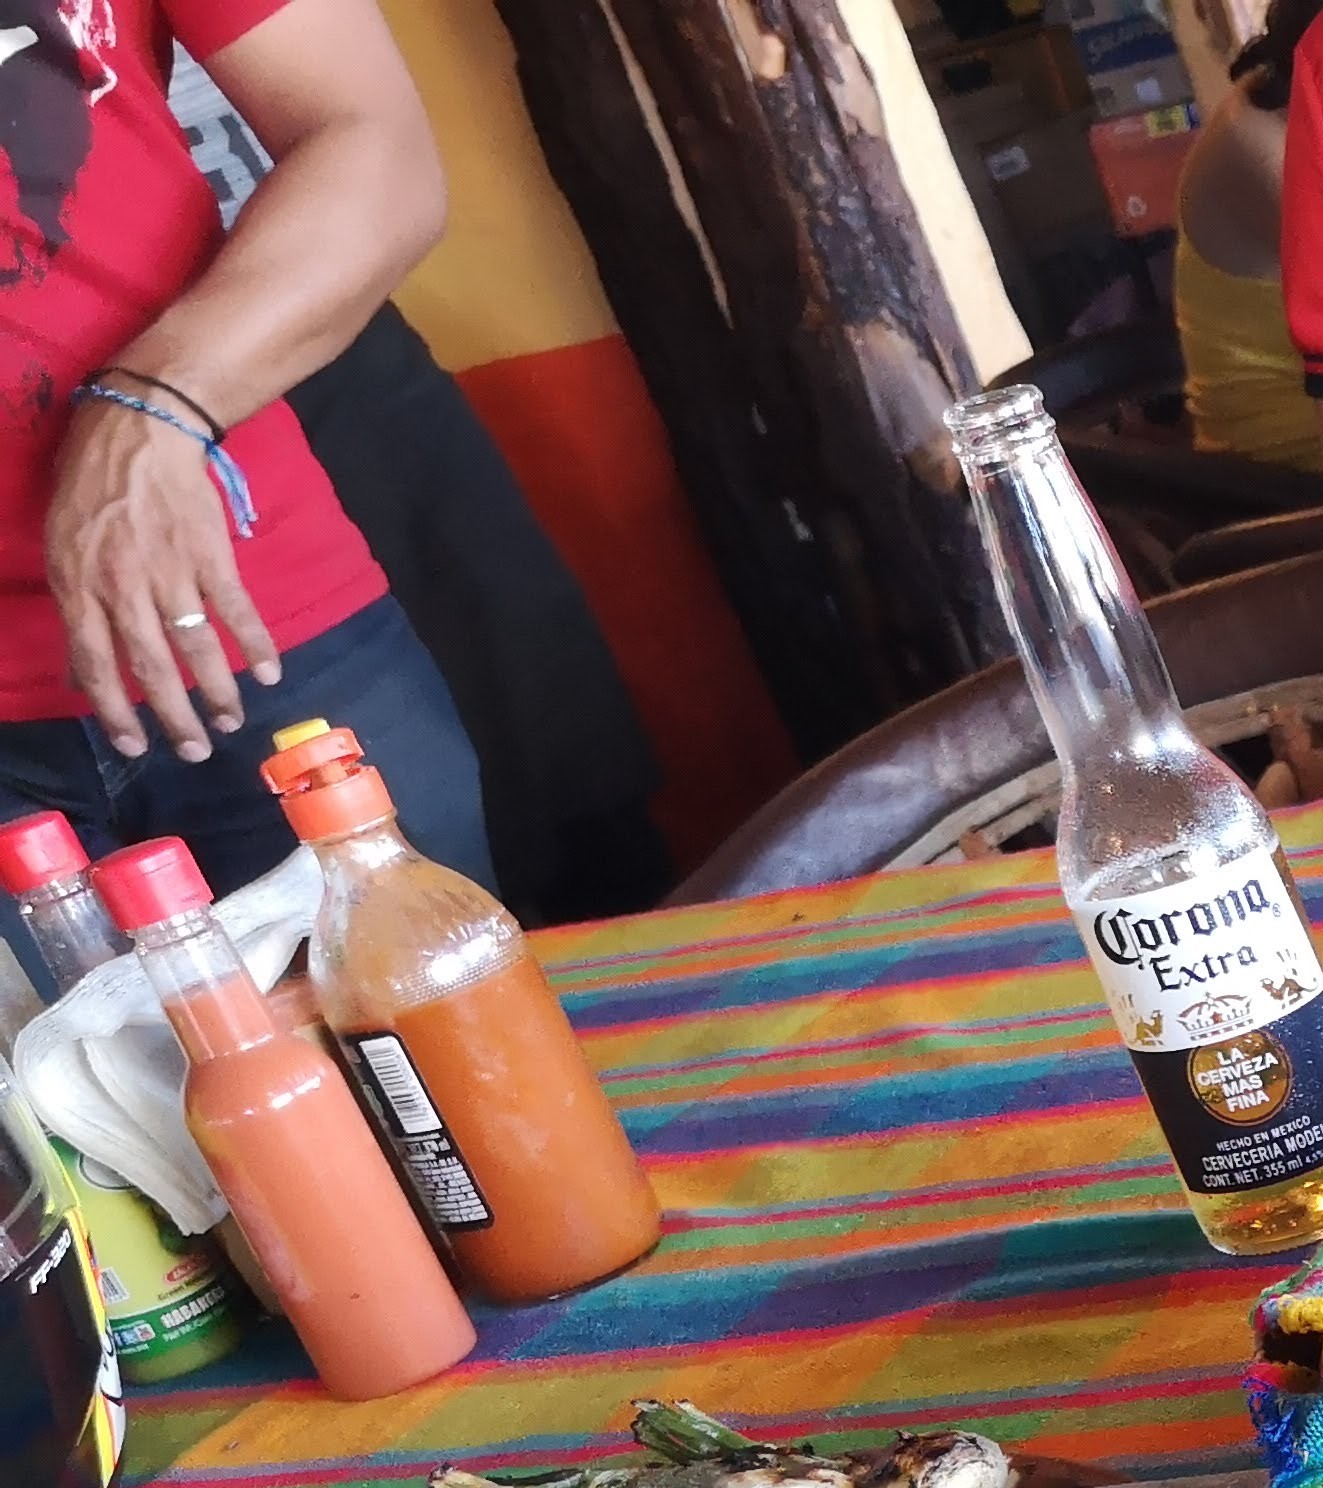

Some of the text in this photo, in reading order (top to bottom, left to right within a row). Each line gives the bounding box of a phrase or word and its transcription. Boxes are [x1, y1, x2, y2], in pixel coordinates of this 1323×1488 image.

[1093, 879, 1271, 971] Corona
[1149, 945, 1259, 992] Extra
[1195, 1051, 1279, 1087] CERVEZA
[1216, 1047, 1245, 1066] LA
[1221, 1074, 1263, 1098] MAS
[1225, 1089, 1270, 1113] FINA
[1216, 1115, 1311, 1152] HECHO EN MEXICO
[1201, 1143, 1285, 1172] CERVECERIA
[1201, 1173, 1236, 1188] CONT.
[1236, 1168, 1264, 1185] NET.
[1264, 1160, 1287, 1179] 355
[1286, 1155, 1304, 1170] ml
